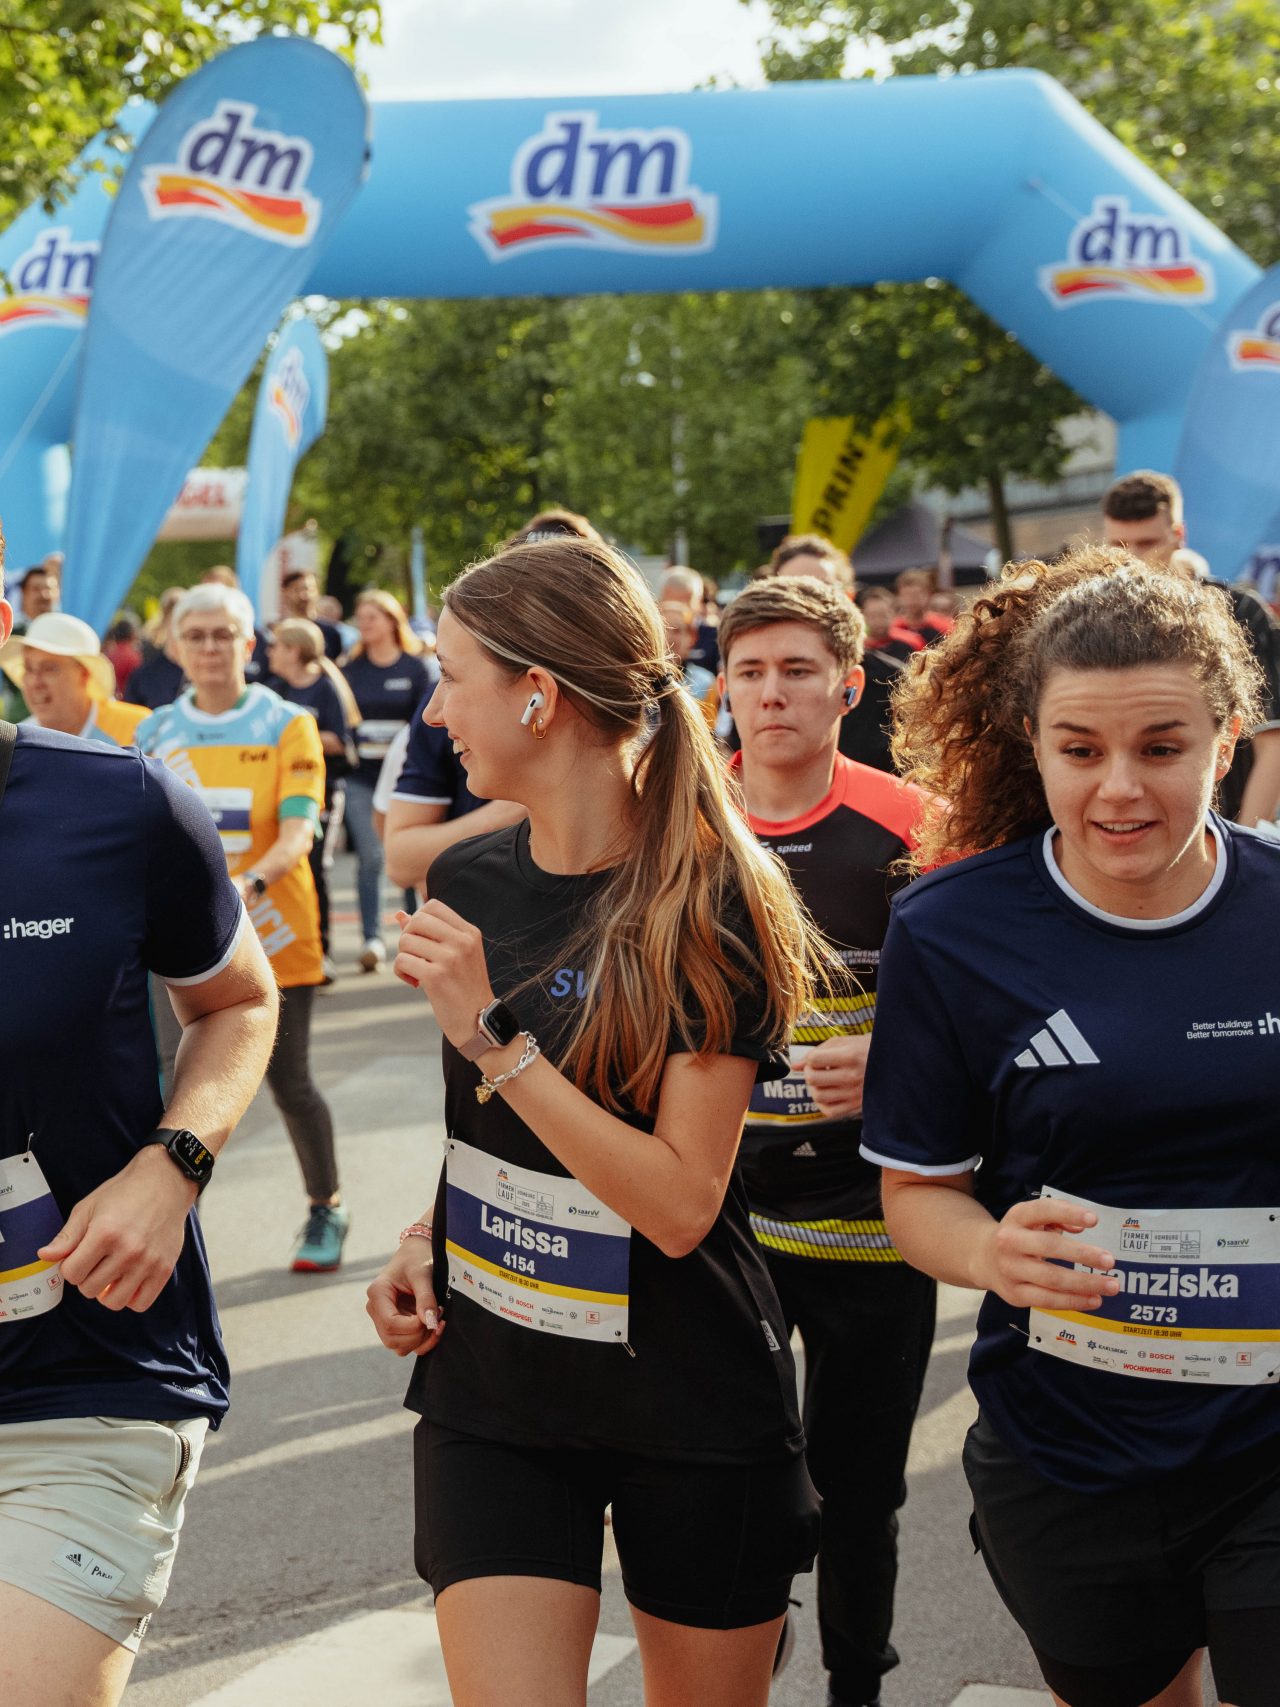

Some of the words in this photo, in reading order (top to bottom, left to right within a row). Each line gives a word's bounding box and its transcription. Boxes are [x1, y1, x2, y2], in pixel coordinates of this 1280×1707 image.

[187, 107, 304, 192] dm
[524, 120, 678, 200] dm
[1077, 207, 1182, 264] dm
[776, 842, 813, 854] spized
[1192, 1021, 1216, 1030] Better
[1217, 1020, 1253, 1029] buildings
[1186, 1031, 1210, 1039] Better
[1212, 1029, 1254, 1037] tomorrows
[497, 1189, 514, 1201] LAUF
[1125, 1217, 1139, 1225] dm
[480, 1203, 569, 1259] Larissa
[1123, 1232, 1149, 1240] FIRMEN
[1122, 1240, 1149, 1250] LAUF
[502, 1251, 536, 1275] 4154
[515, 1299, 534, 1310] BOSCH
[1130, 1304, 1178, 1323] 2573
[1059, 1329, 1076, 1340] dm
[1123, 1325, 1152, 1336] STARTZEIT
[1169, 1330, 1182, 1338] UHR
[1098, 1343, 1128, 1355] KARLSBERG
[1149, 1352, 1175, 1360] BOSCH
[1123, 1363, 1173, 1375] WOCHENSPIEGEL
